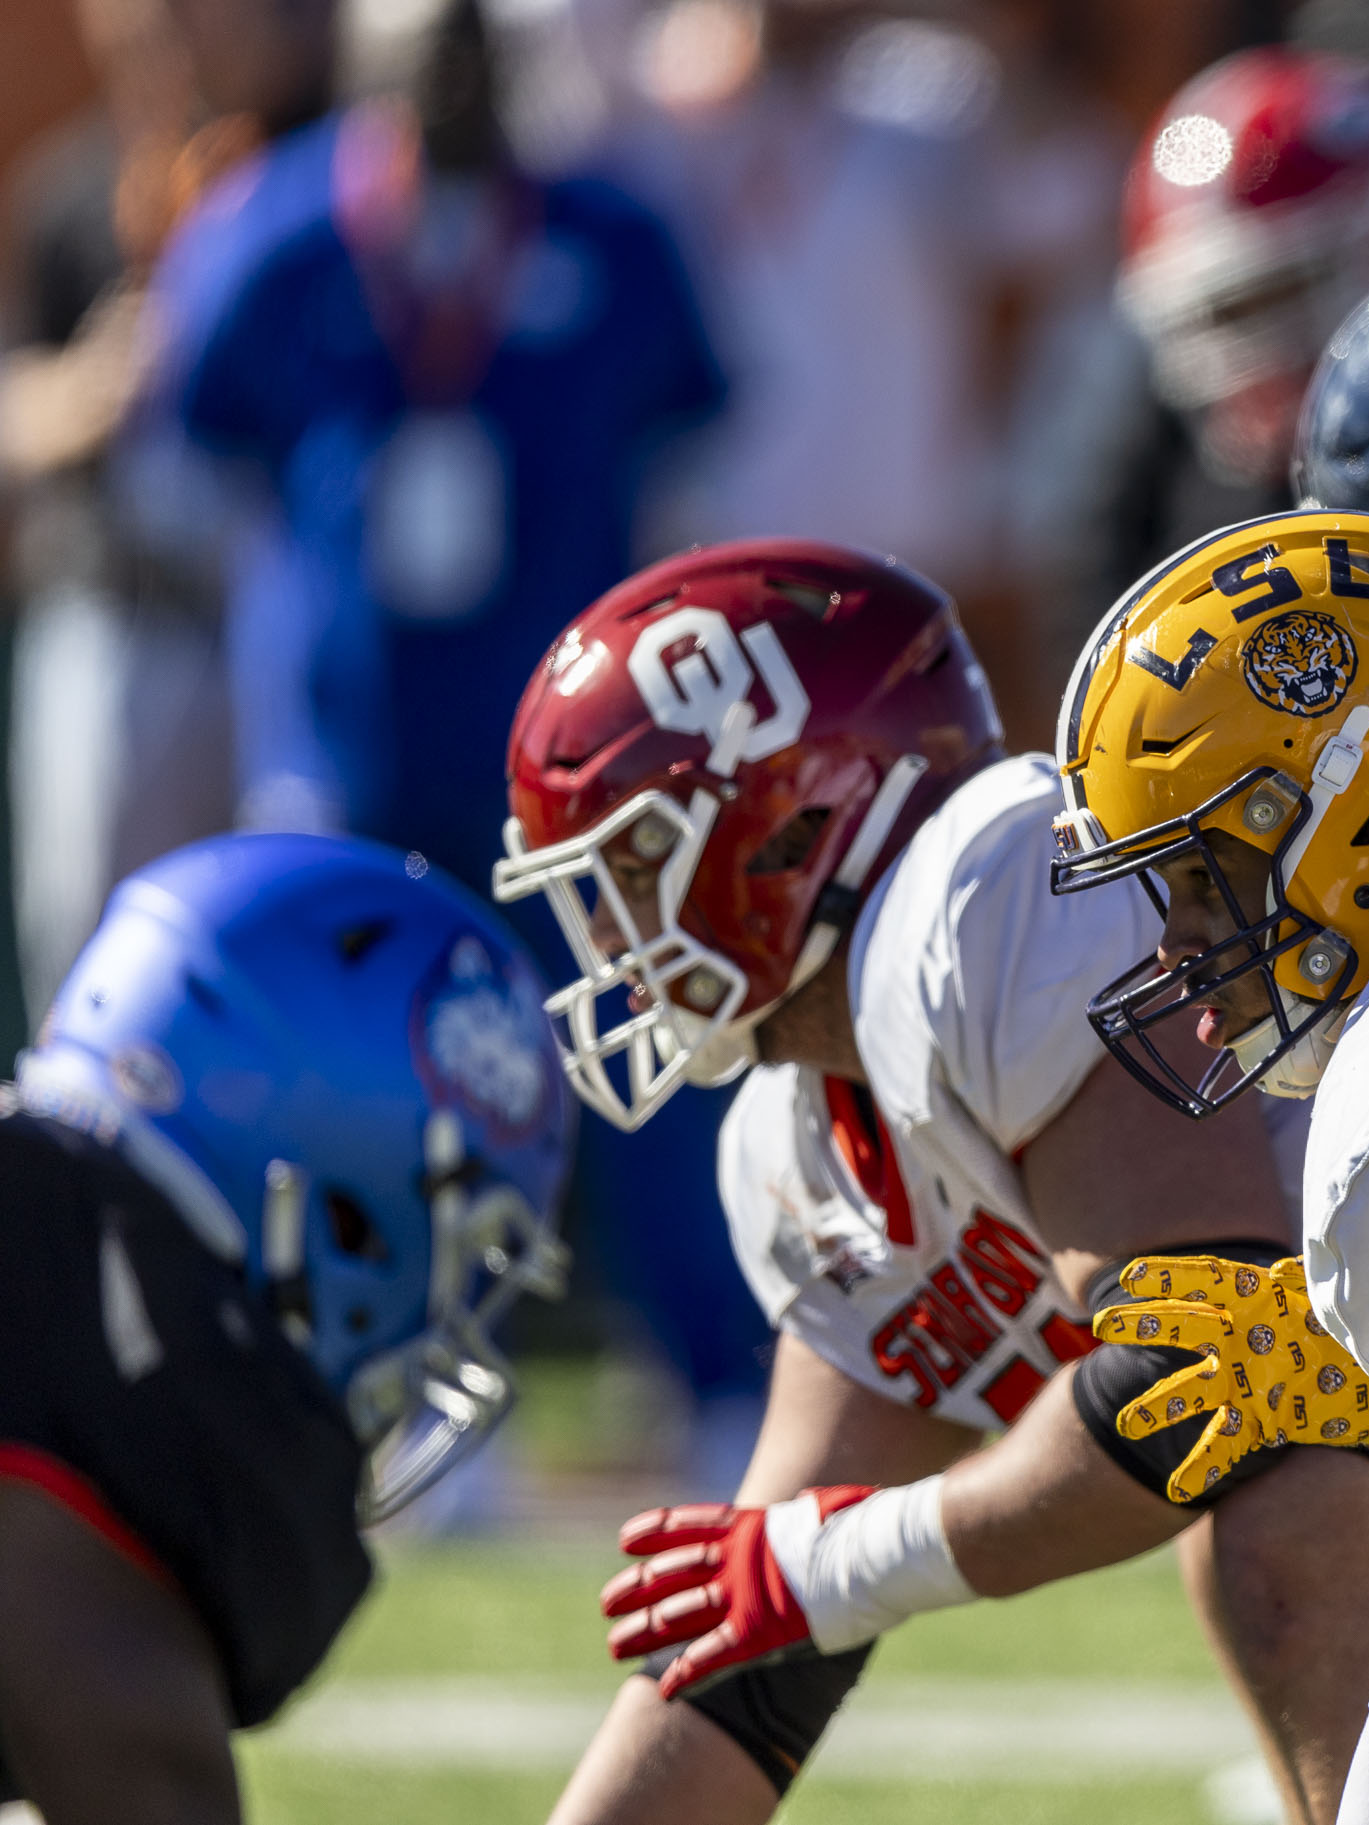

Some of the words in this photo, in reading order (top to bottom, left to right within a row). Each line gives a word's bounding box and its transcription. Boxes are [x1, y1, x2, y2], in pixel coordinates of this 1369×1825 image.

[628, 606, 812, 764] OU
[1159, 1269, 1172, 1297] SU
[1271, 1283, 1290, 1318] LSU
[1287, 1341, 1306, 1374] LSU
[1231, 1361, 1254, 1399] LSU
[1293, 1395, 1308, 1430] LSU
[1355, 1383, 1369, 1413] LSU
